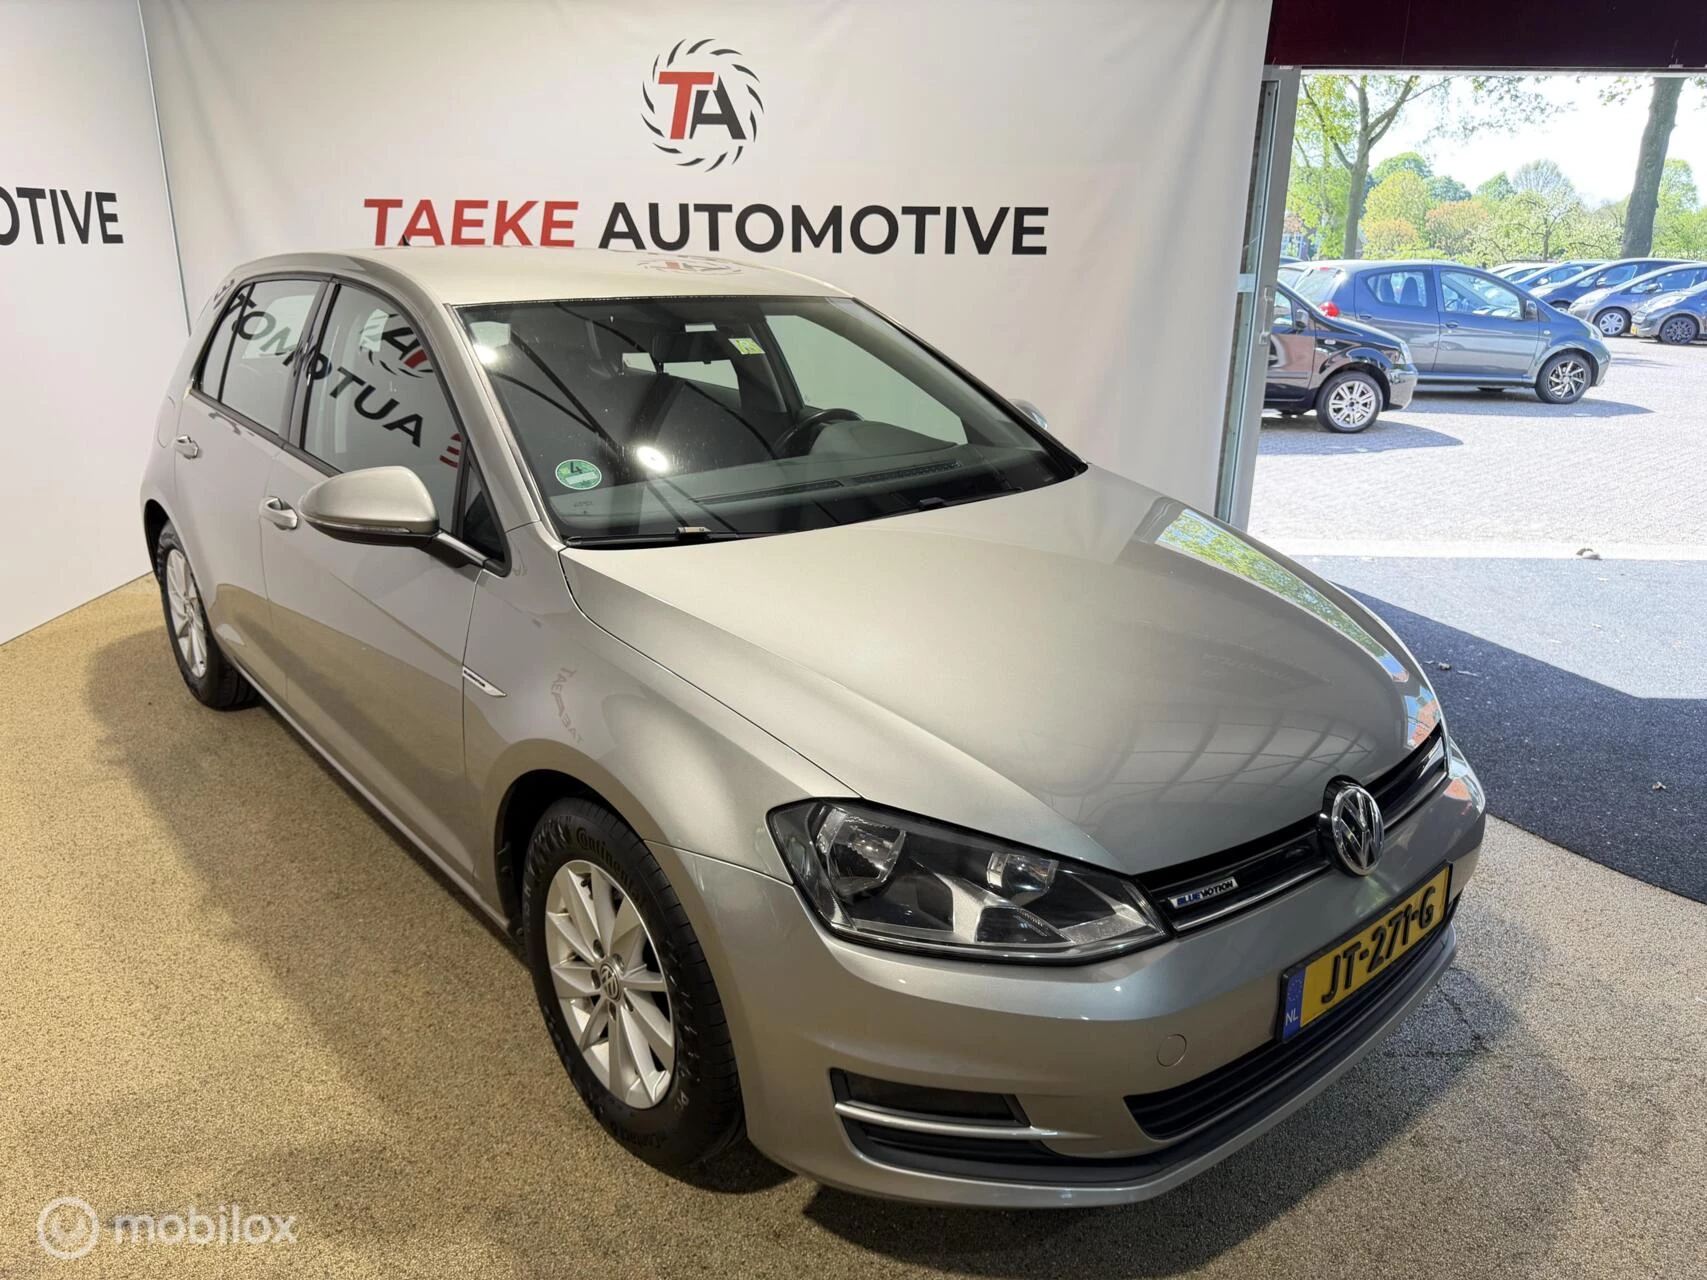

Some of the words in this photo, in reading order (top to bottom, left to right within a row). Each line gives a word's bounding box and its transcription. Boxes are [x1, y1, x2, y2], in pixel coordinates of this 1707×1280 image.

[656, 70, 748, 141] TA
[363, 198, 580, 248] TAEKE
[598, 201, 1050, 256] AUTOMOTIVE
[1320, 886, 1436, 1005] JT-271-G
[1285, 1007, 1299, 1026] NL
